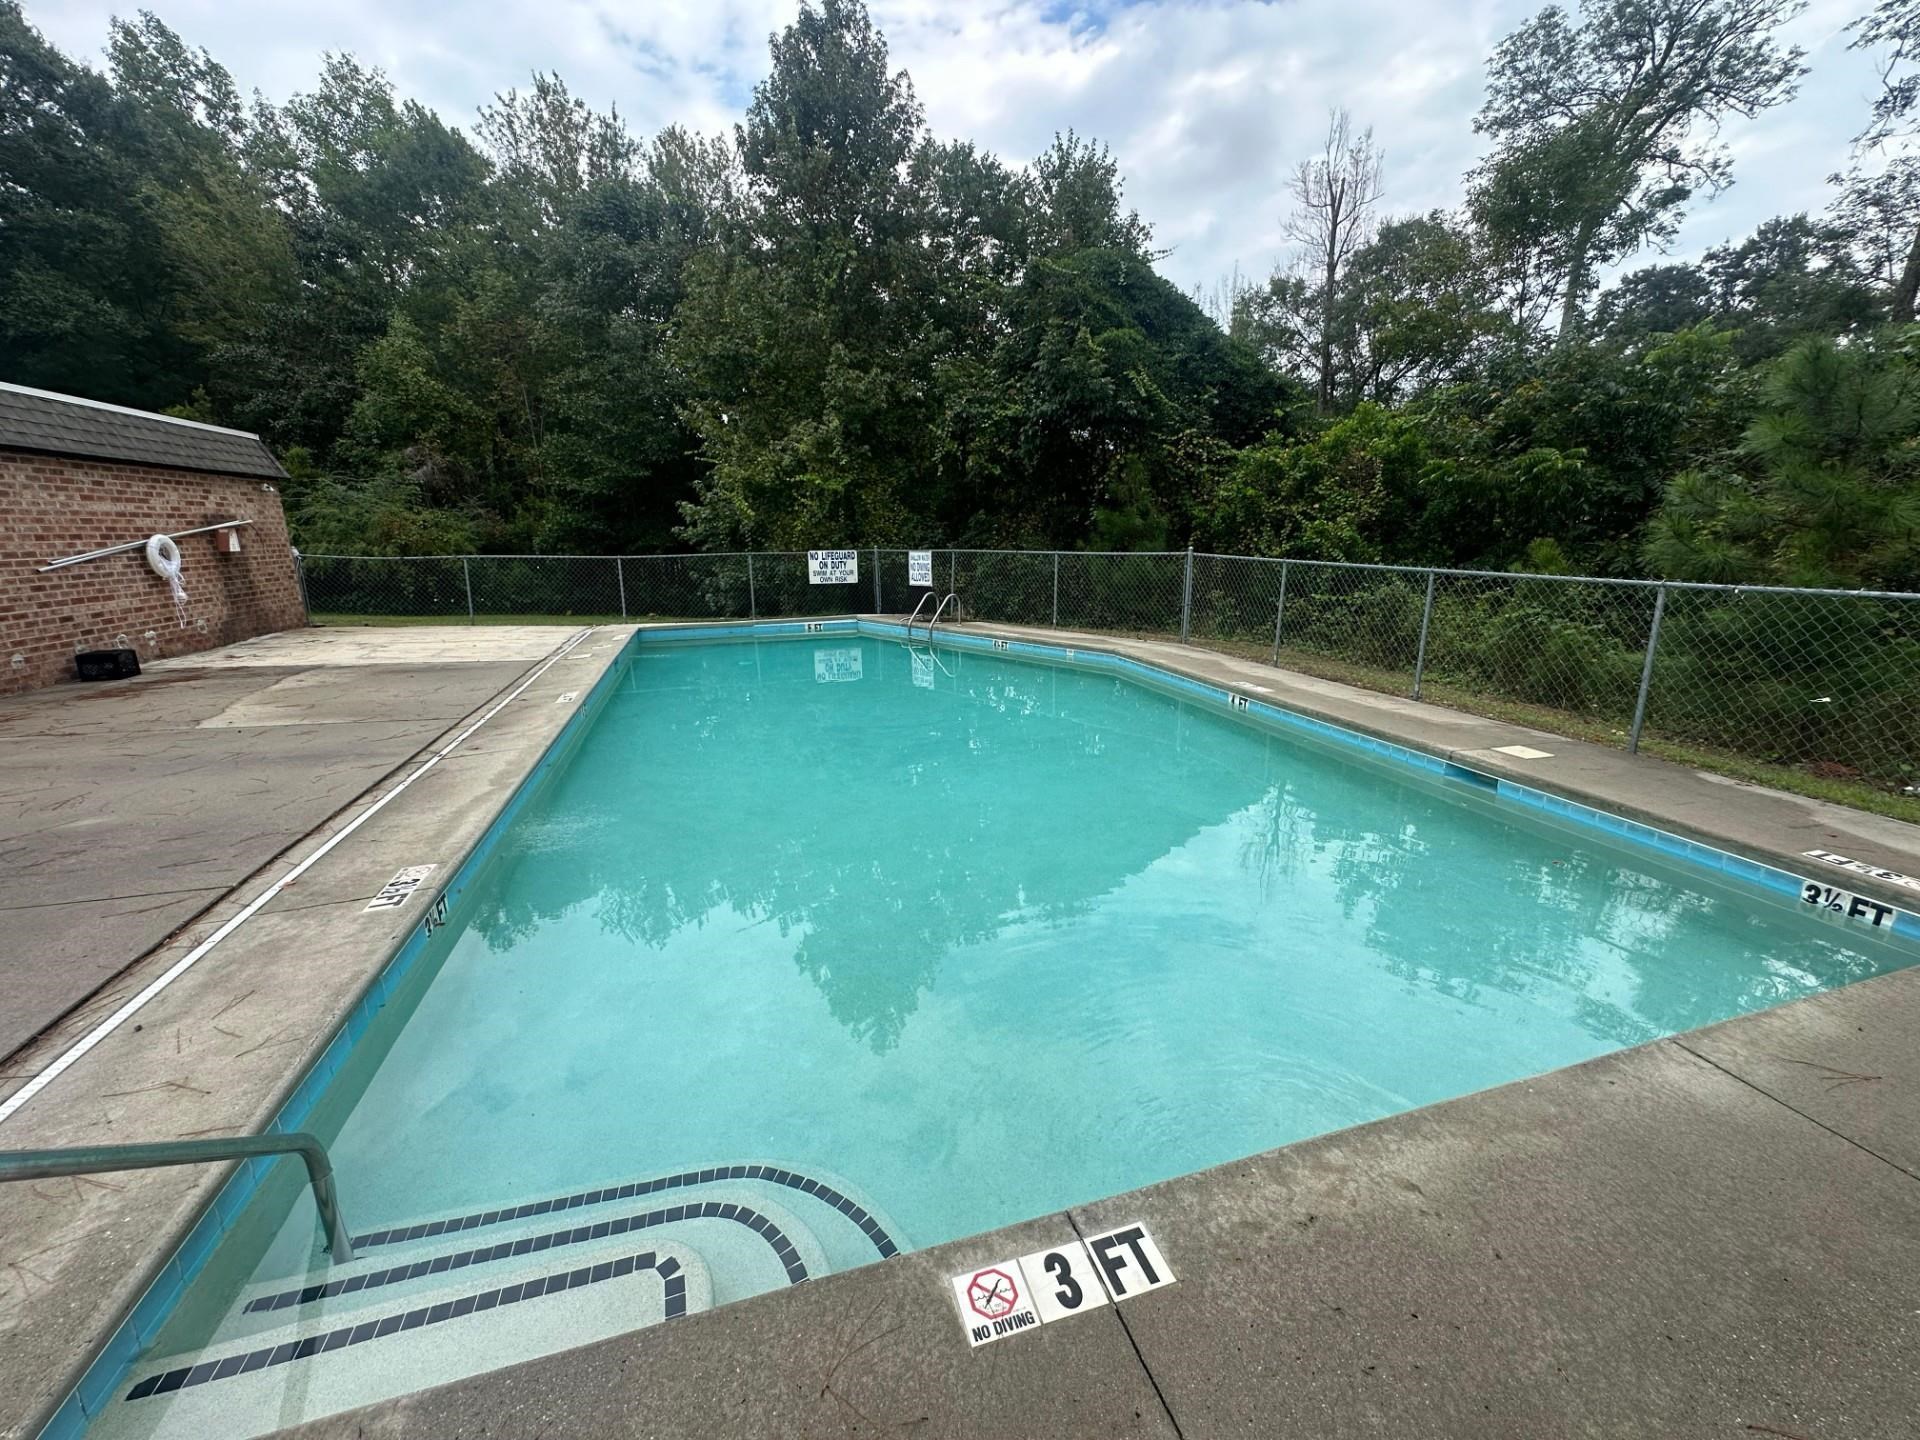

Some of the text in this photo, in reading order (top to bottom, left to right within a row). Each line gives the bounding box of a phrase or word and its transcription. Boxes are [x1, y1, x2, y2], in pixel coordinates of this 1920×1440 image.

[809, 551, 856, 561] NO LIFEGUARD
[819, 560, 847, 570] ON DUTY
[911, 572, 930, 582] ALLOWED
[1239, 697, 1248, 708] FT
[1806, 852, 1855, 866] FT
[368, 892, 410, 909] FT
[435, 892, 448, 922] FT
[1847, 894, 1894, 927] FT
[1044, 1226, 1161, 1310] 3 FT
[971, 1310, 1036, 1343] NO DIVING
